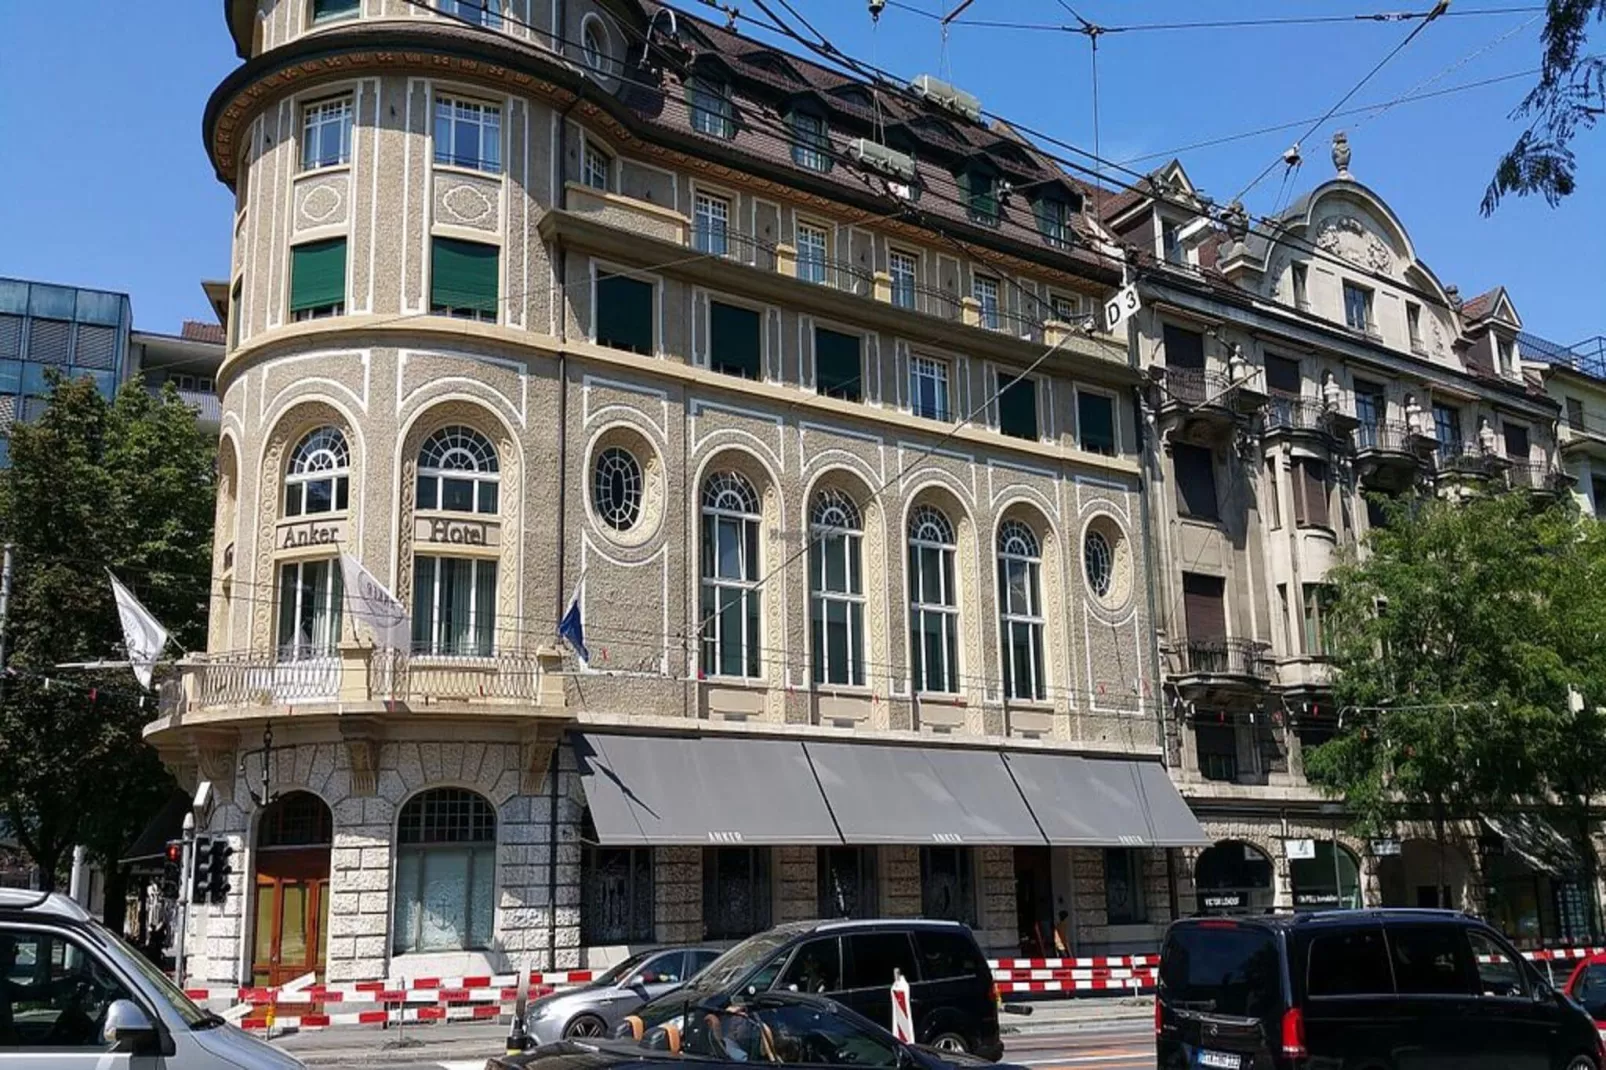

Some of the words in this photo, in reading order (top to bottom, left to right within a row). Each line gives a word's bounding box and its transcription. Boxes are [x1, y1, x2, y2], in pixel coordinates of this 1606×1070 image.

[1108, 302, 1120, 325] D
[1126, 291, 1136, 309] 3
[283, 522, 340, 549] Anker
[429, 518, 487, 545] Hotel
